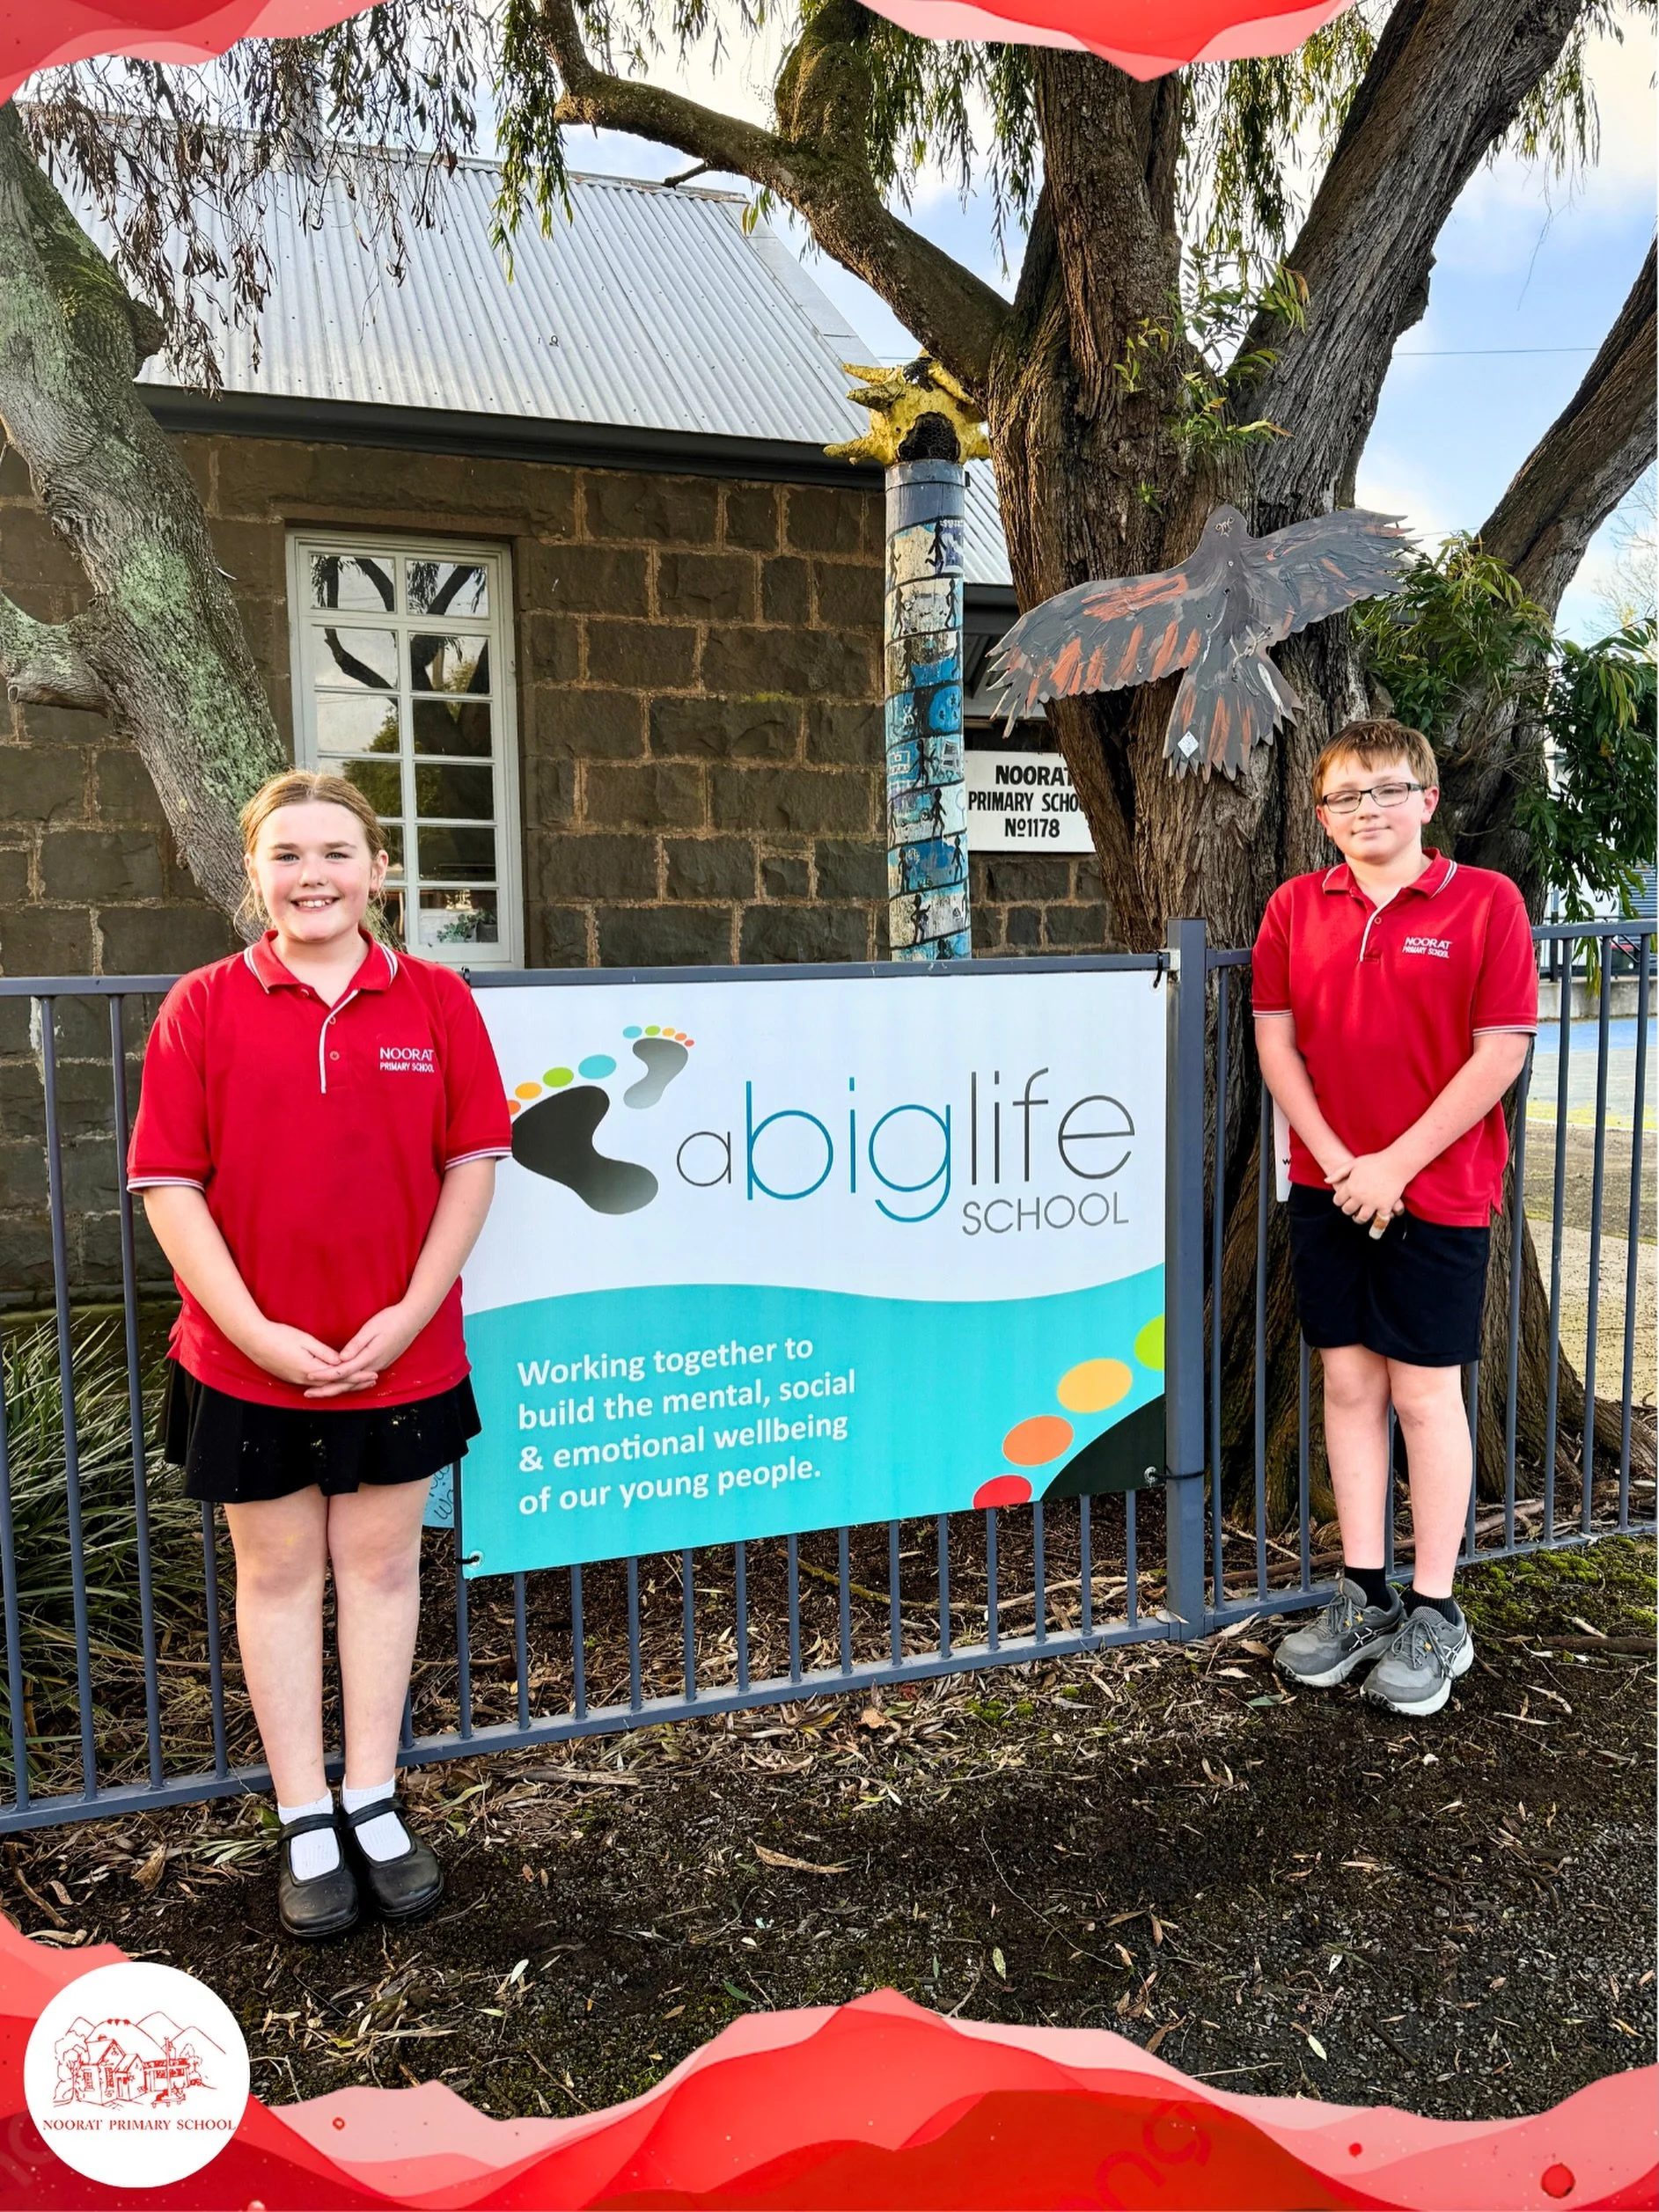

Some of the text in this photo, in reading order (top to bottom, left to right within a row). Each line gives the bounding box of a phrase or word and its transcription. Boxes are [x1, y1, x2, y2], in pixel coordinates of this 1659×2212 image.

[968, 792, 1084, 812] PRIMARY SCHO
[1405, 937, 1452, 949] NOORAT
[1428, 948, 1450, 958] SCHOOL
[379, 1047, 434, 1061] NOORAT
[379, 1062, 435, 1073] PRIMARY SCHOOL
[962, 1191, 1129, 1235] SCHOOL
[518, 1337, 813, 1387] Working together to
[519, 1369, 855, 1430] build the mental, social
[519, 1413, 848, 1472] & emotional wellbeing
[519, 1456, 821, 1515] of our young people.
